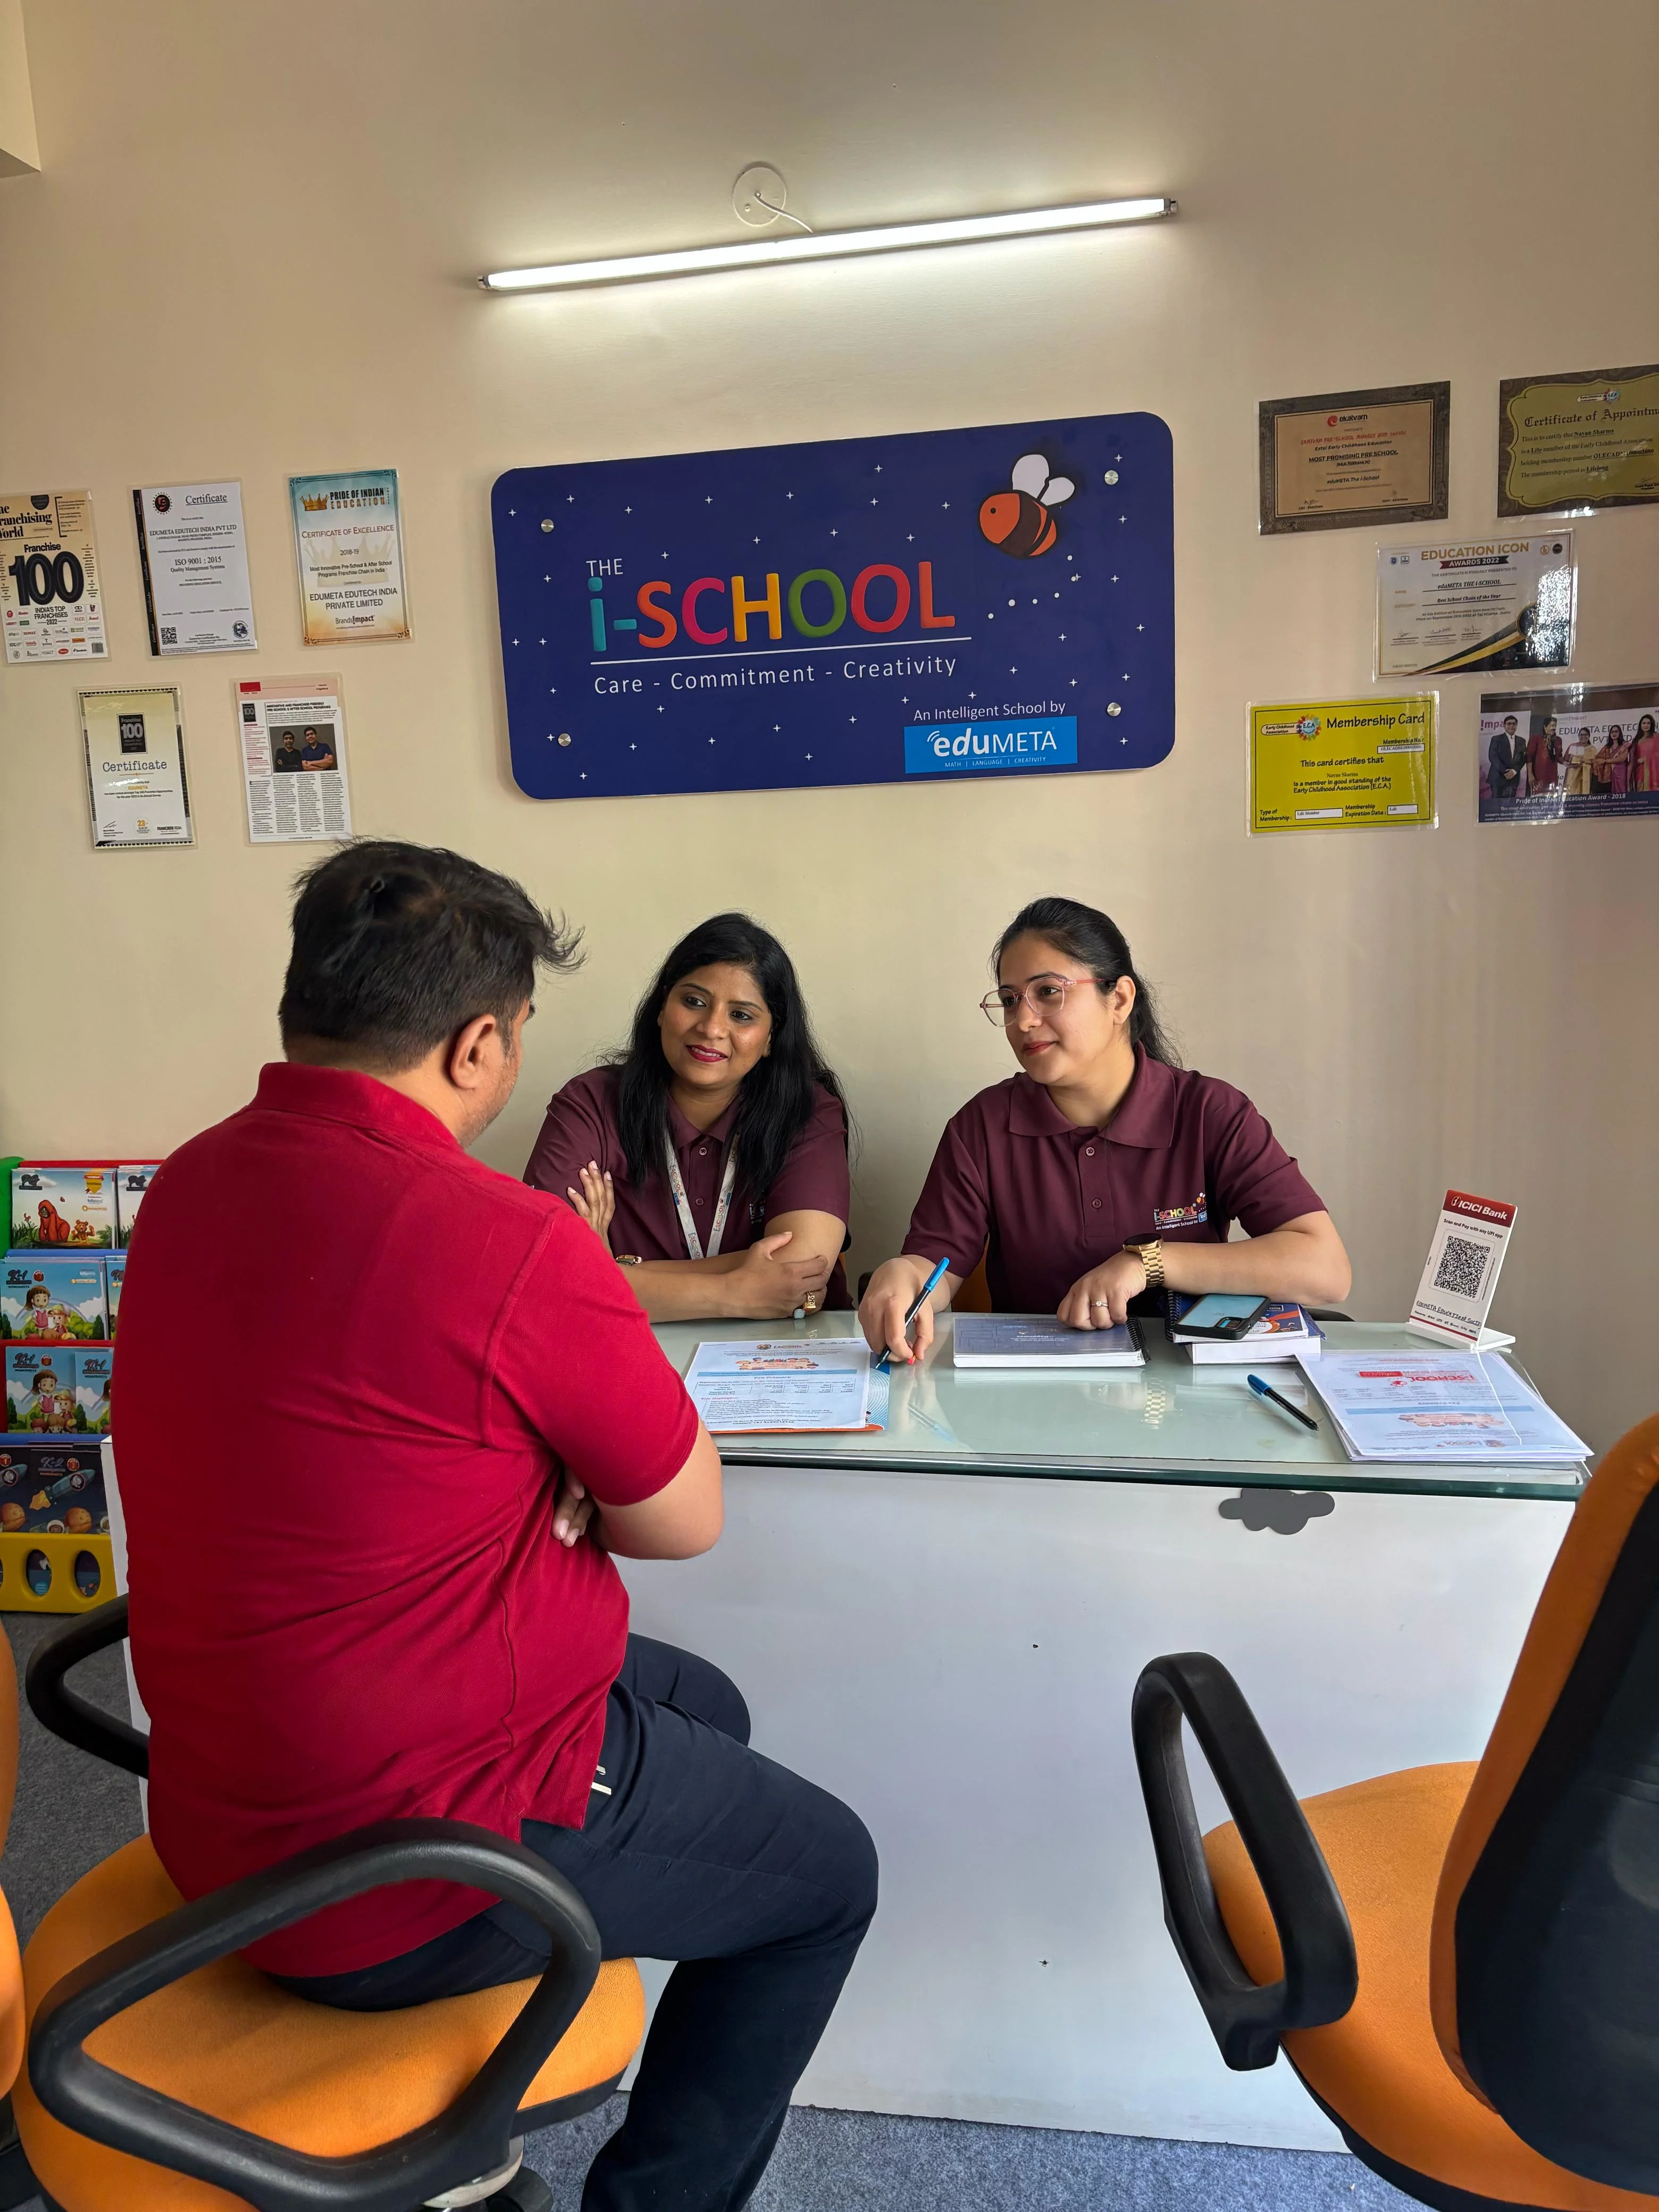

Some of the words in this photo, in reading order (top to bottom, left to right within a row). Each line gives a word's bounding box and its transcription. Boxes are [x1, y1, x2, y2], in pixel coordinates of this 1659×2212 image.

[1524, 414, 1582, 427] Certificate
[1586, 410, 1597, 421] of
[186, 493, 228, 504] Certificate
[330, 490, 350, 500] PRIDE
[351, 490, 359, 499] OF
[361, 488, 384, 498] INDIAN
[331, 497, 385, 509] EDUCATION
[302, 529, 342, 538] CERTIFICATE
[353, 525, 395, 534] EXCELLENCE
[24, 542, 61, 553] Franchise
[1421, 547, 1494, 561] EDUCATION
[1498, 542, 1529, 554] ICON
[586, 558, 624, 577] THE
[1449, 558, 1480, 567] AWARDS
[9, 551, 84, 606] 100
[309, 592, 343, 601] EDUMETA
[345, 590, 376, 599] EDUTECH
[325, 601, 355, 610] PRIVATE
[356, 599, 383, 607] LIMITED
[588, 561, 955, 651] i-SCHOOL
[594, 677, 643, 694] Care
[671, 665, 815, 690] Commitment
[843, 655, 957, 678] Creativity
[914, 710, 931, 722] An
[935, 705, 999, 720] Intelligent
[1003, 701, 1046, 716] School
[1050, 700, 1066, 715] by
[1327, 715, 1395, 730] Membership
[1398, 713, 1425, 724] Card
[121, 723, 144, 739] 100
[934, 728, 1057, 757] eduMETA
[102, 760, 167, 773] Certificate
[1317, 758, 1333, 767] card
[1335, 757, 1365, 766] certifies
[1459, 1200, 1482, 1213] ICICI
[1482, 1206, 1507, 1220] Bank
